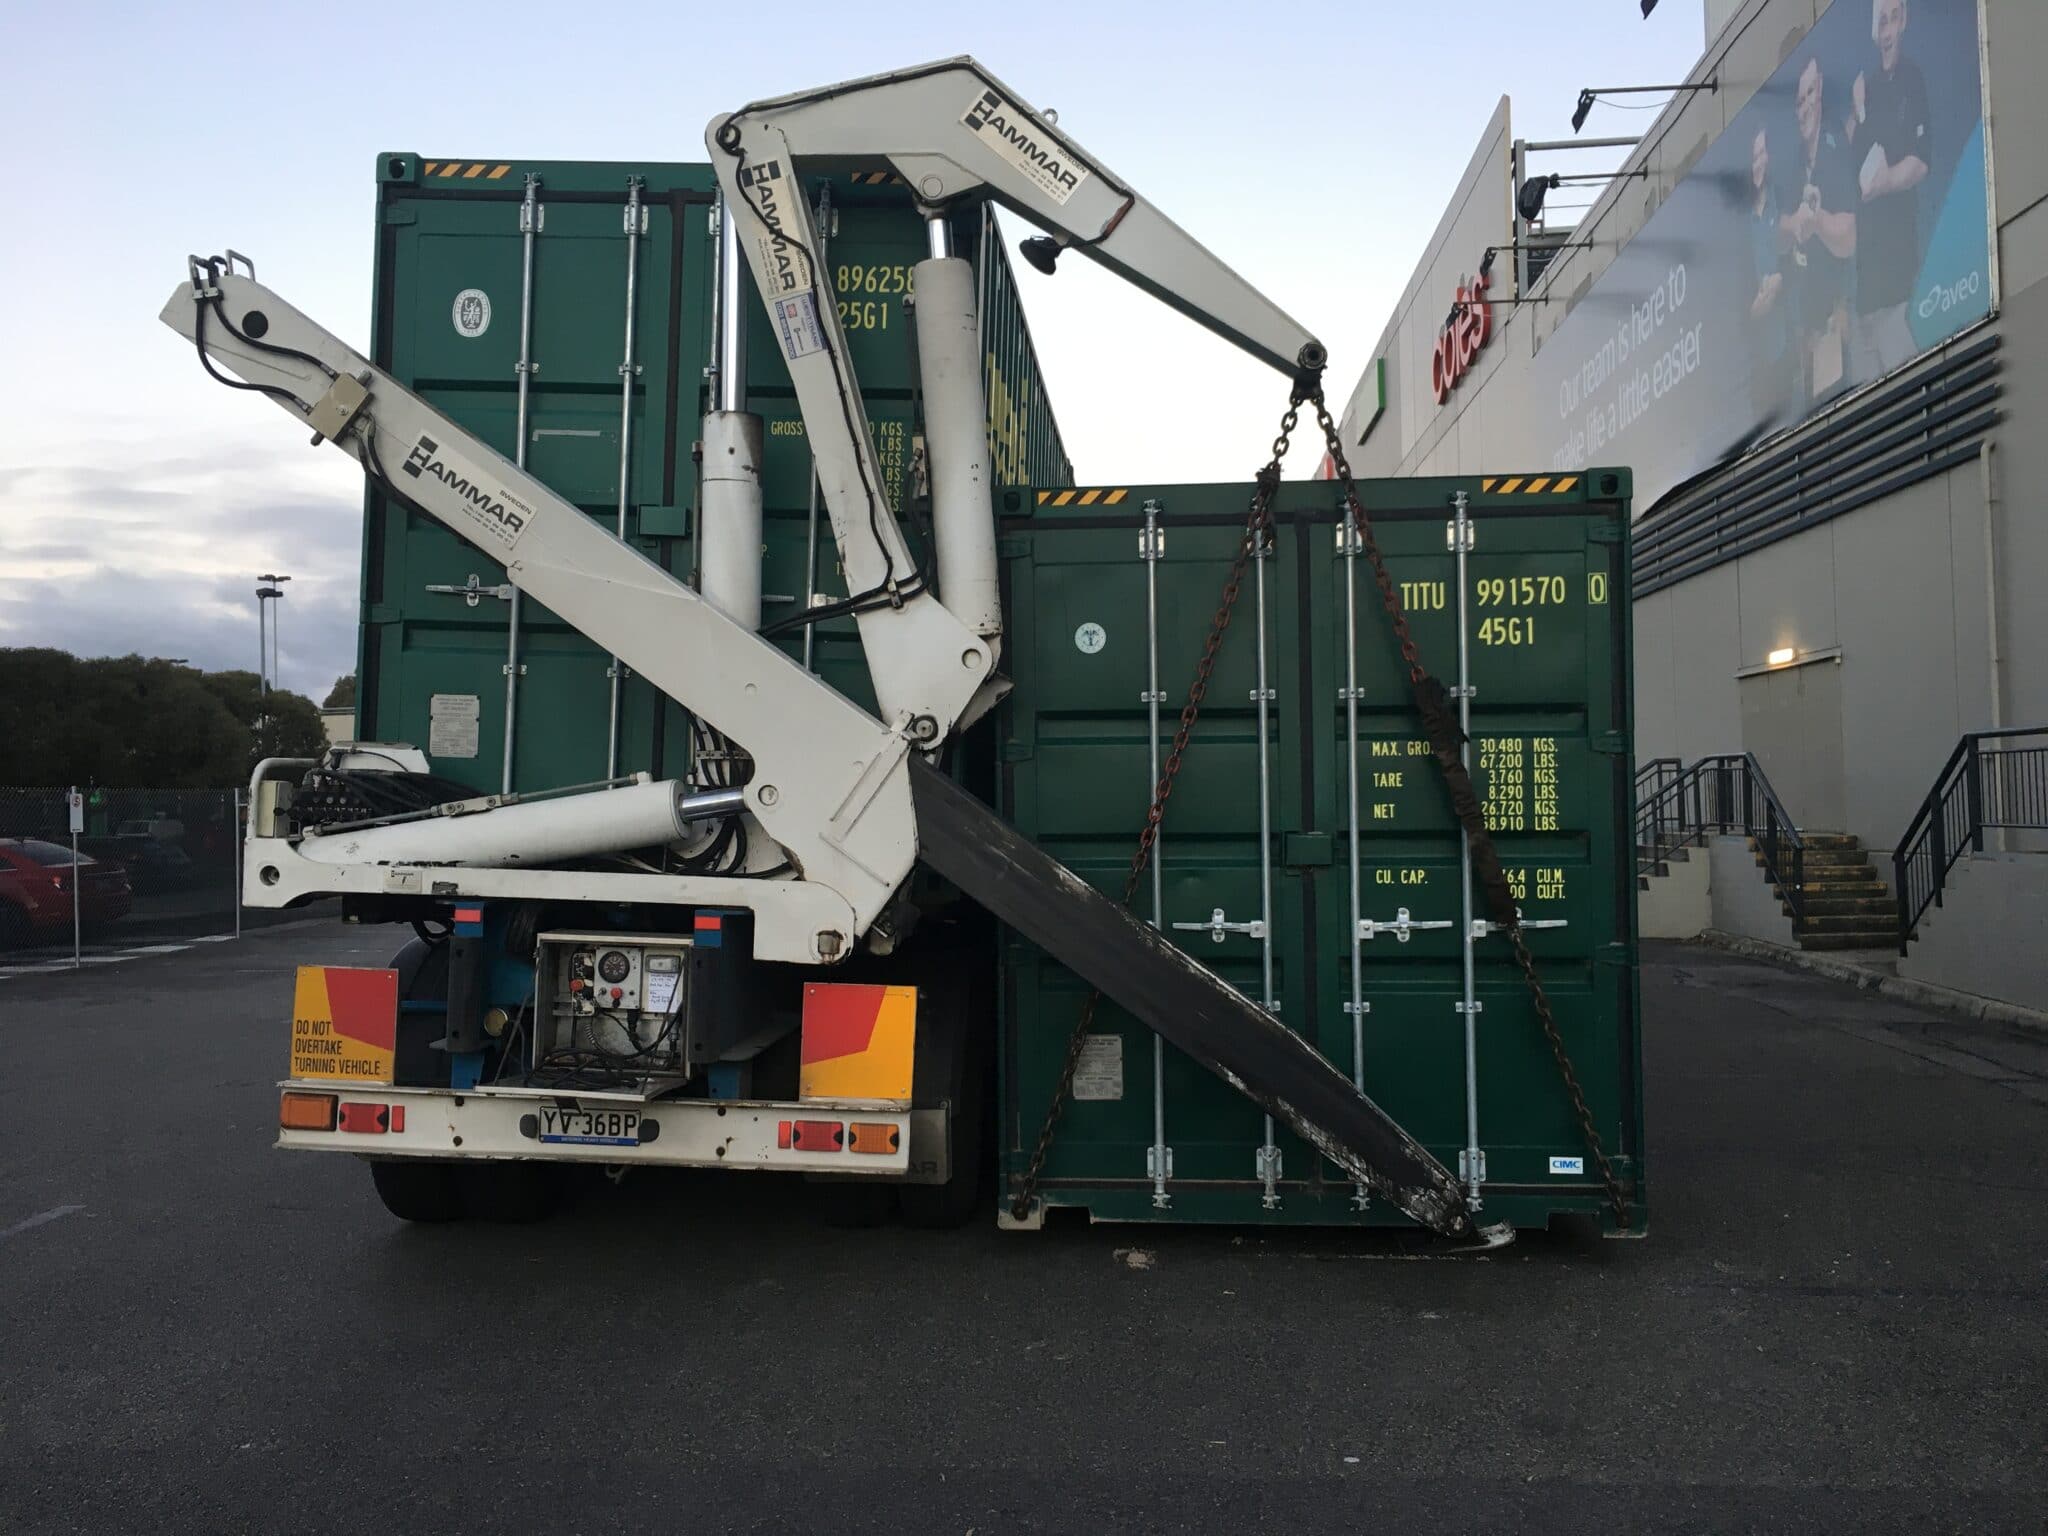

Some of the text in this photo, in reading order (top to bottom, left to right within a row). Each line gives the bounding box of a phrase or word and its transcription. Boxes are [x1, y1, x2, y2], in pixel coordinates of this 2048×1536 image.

[972, 100, 1078, 191] HAMMAR
[752, 164, 796, 290] HAMMAR
[1941, 271, 1979, 312] aveo
[837, 302, 888, 330] 25G1
[1559, 263, 1687, 419] Our team is here to
[1553, 321, 1703, 472] make life a little easier
[771, 421, 803, 436] GROSS
[886, 467, 904, 482] BS.
[409, 446, 524, 533] HAMMAR
[886, 482, 904, 497] GS.
[1400, 574, 1606, 610] TITU 991570 0
[1478, 616, 1535, 645] 45G1
[1372, 741, 1402, 756] MAX.
[1533, 737, 1559, 753] KGS.
[1534, 753, 1559, 768] LBS.
[1373, 772, 1403, 788] TARE
[1534, 769, 1559, 784] KGS.
[1534, 784, 1559, 800] LBS.
[1374, 803, 1395, 818] NET
[1534, 801, 1560, 816] KGS.
[1534, 816, 1560, 831] LBS.
[1376, 870, 1395, 884] CU.
[1401, 869, 1428, 884] CAP.
[296, 1019, 331, 1036] DO NOT
[295, 1038, 343, 1055] OVERTAKE
[294, 1057, 381, 1075] TURNING VEHICLE
[1552, 1160, 1580, 1169] CIMC
